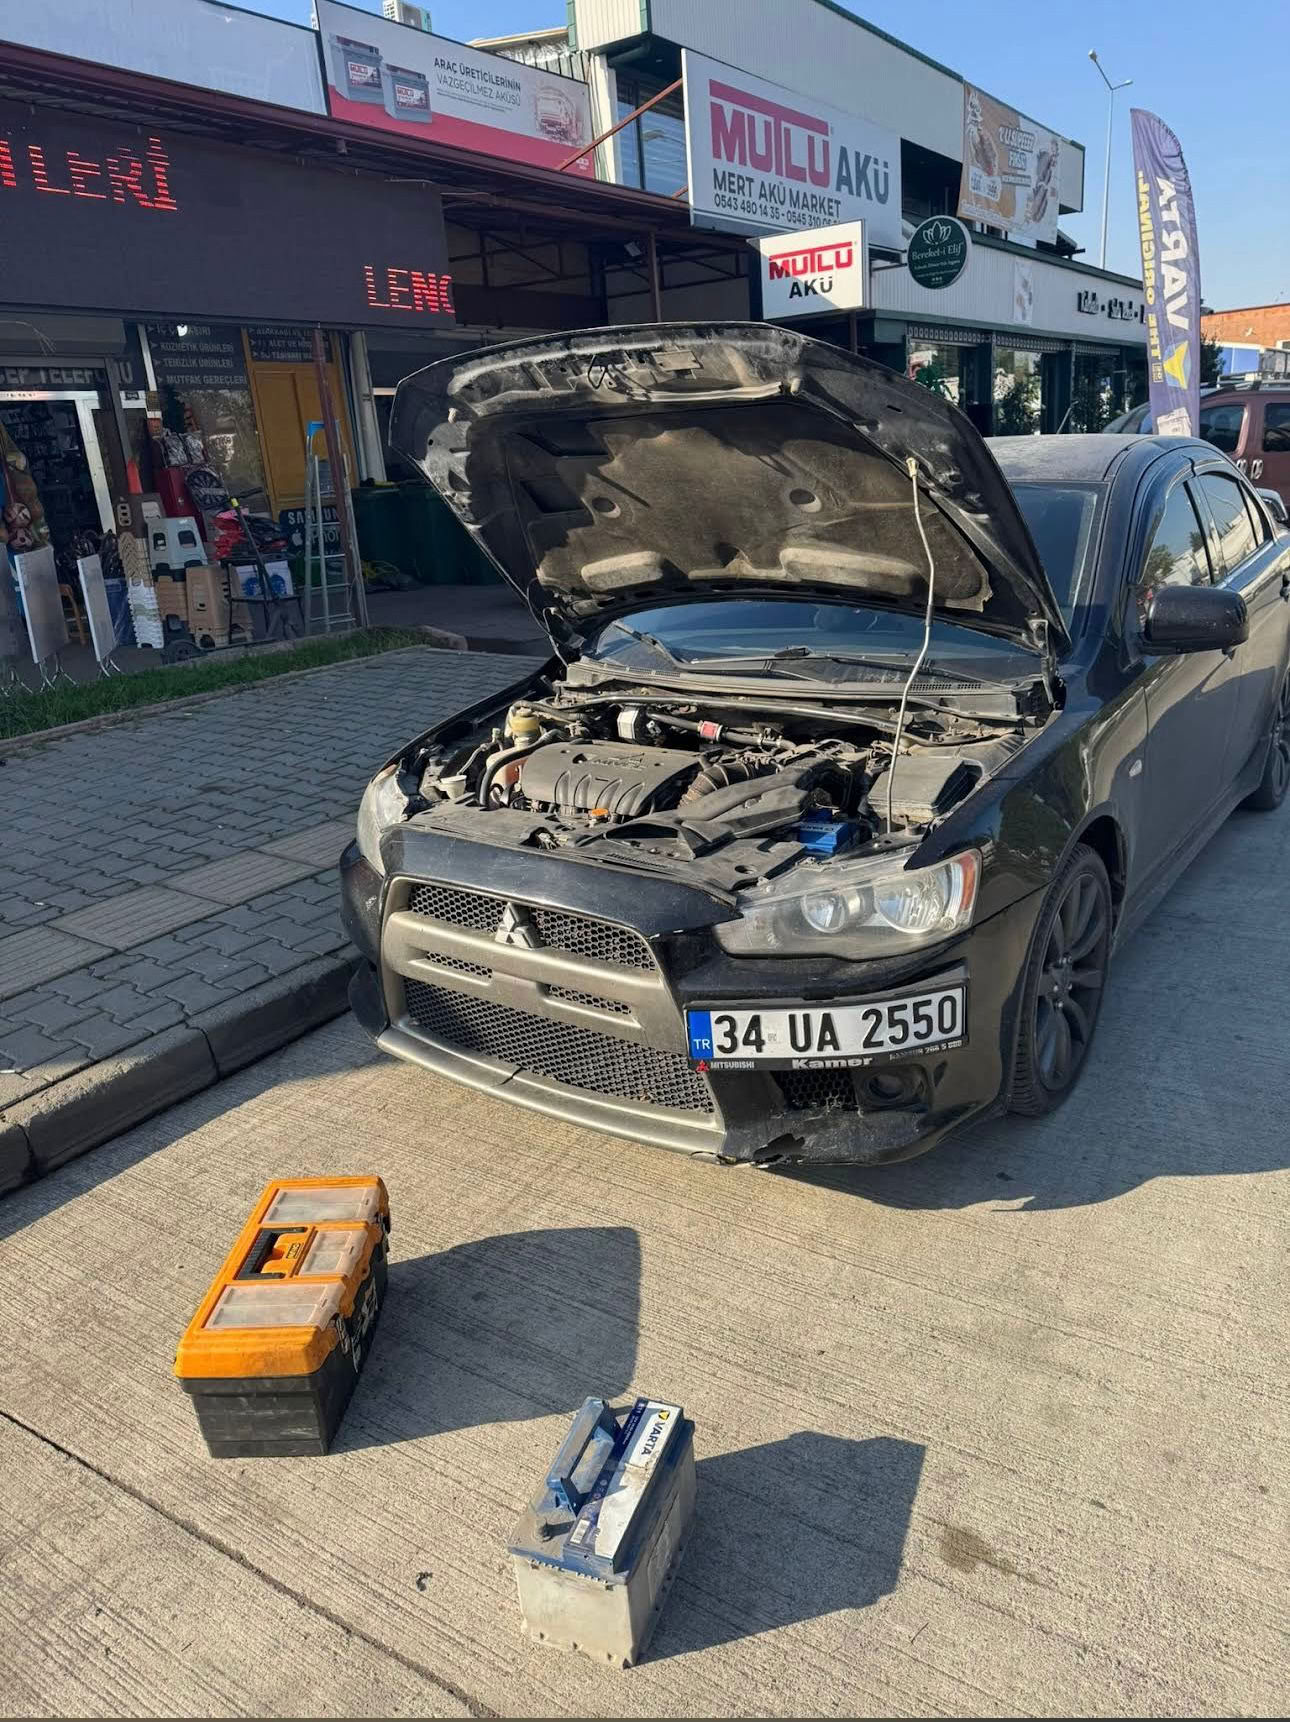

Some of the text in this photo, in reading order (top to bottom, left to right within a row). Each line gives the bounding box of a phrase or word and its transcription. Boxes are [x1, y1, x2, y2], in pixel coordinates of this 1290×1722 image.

[434, 57, 457, 74] ARAÇ
[709, 79, 889, 205] MUTLU AKÜ
[713, 168, 841, 218] MERT AKÜ MARKET
[713, 193, 738, 210] 0543
[740, 199, 757, 215] 480
[760, 204, 769, 217] 14
[770, 206, 780, 220] 35
[768, 241, 852, 280] MUTLU
[789, 276, 833, 299] AKÜ
[693, 995, 957, 1054] TR 34 UA 2550
[711, 1057, 873, 1070] MITSUBISHI Kamer
[641, 1421, 666, 1455] VARTA
